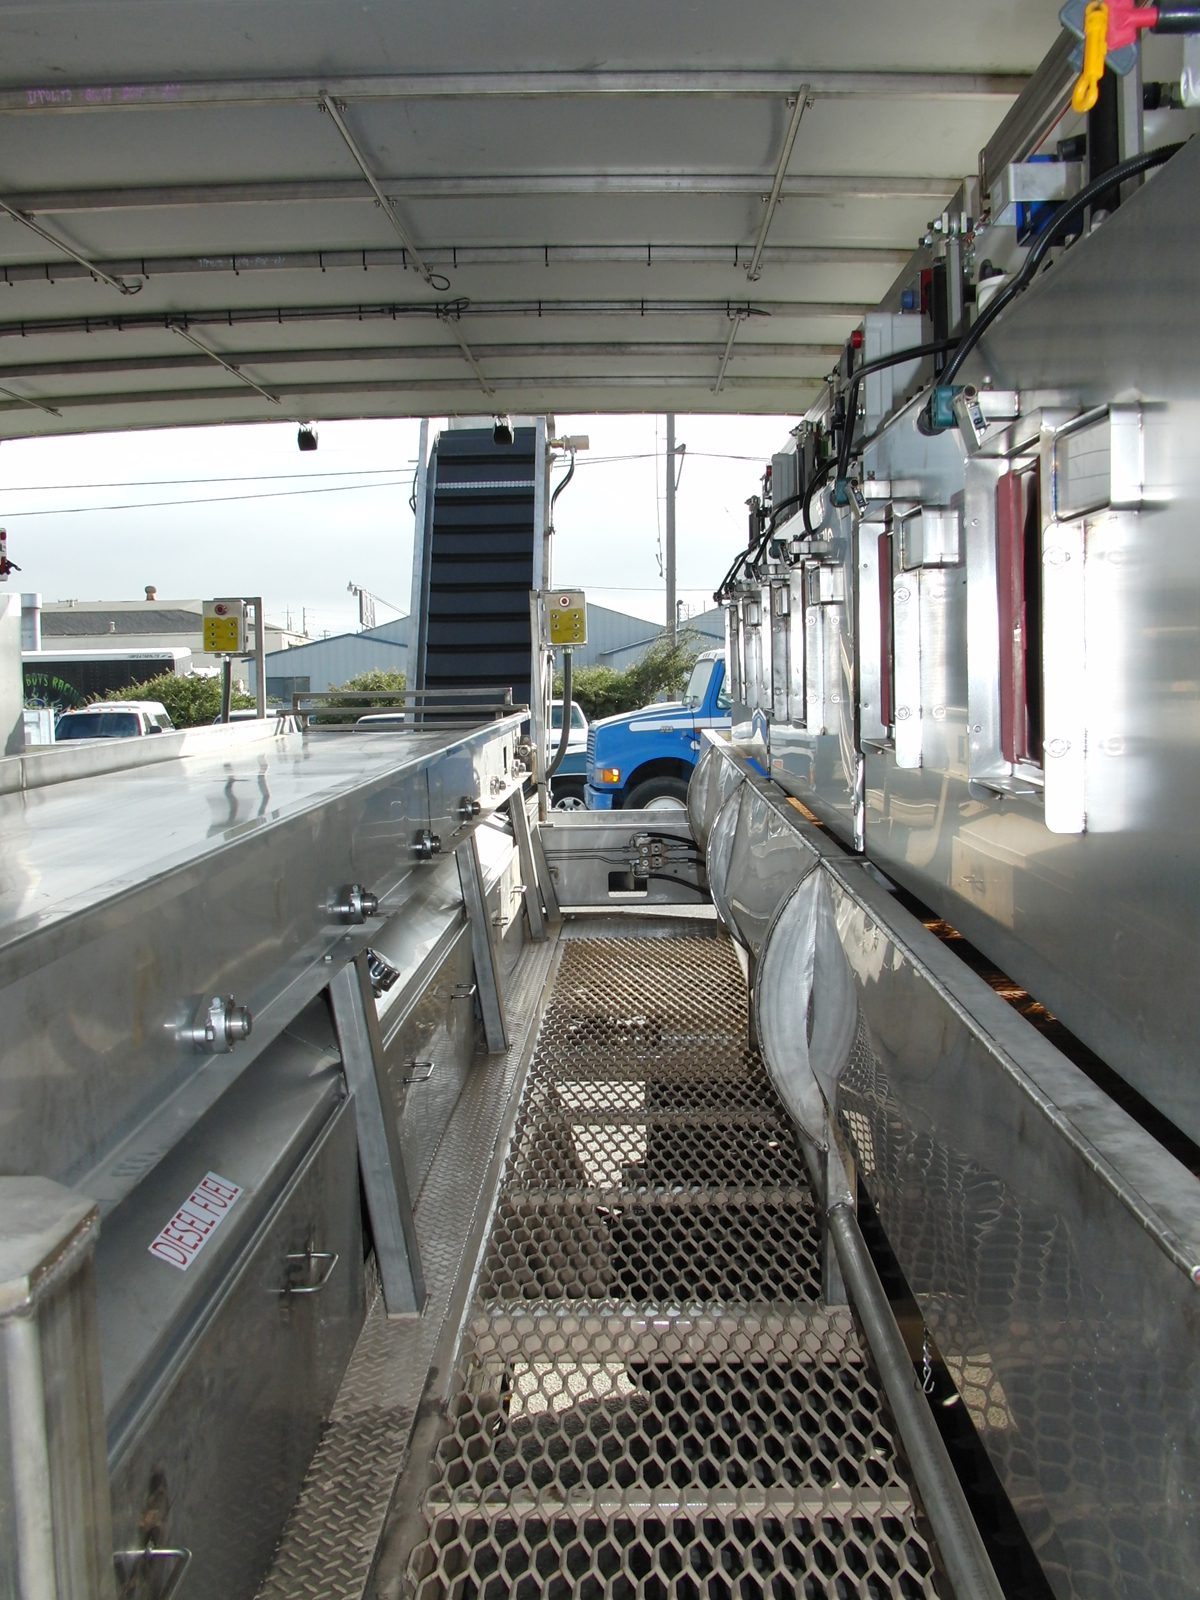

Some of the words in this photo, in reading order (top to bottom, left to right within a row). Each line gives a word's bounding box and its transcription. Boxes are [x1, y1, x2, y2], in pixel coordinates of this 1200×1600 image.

[25, 673, 48, 687] BOYS
[151, 1209, 215, 1265] DIESEL
[190, 1178, 239, 1217] FUEL
